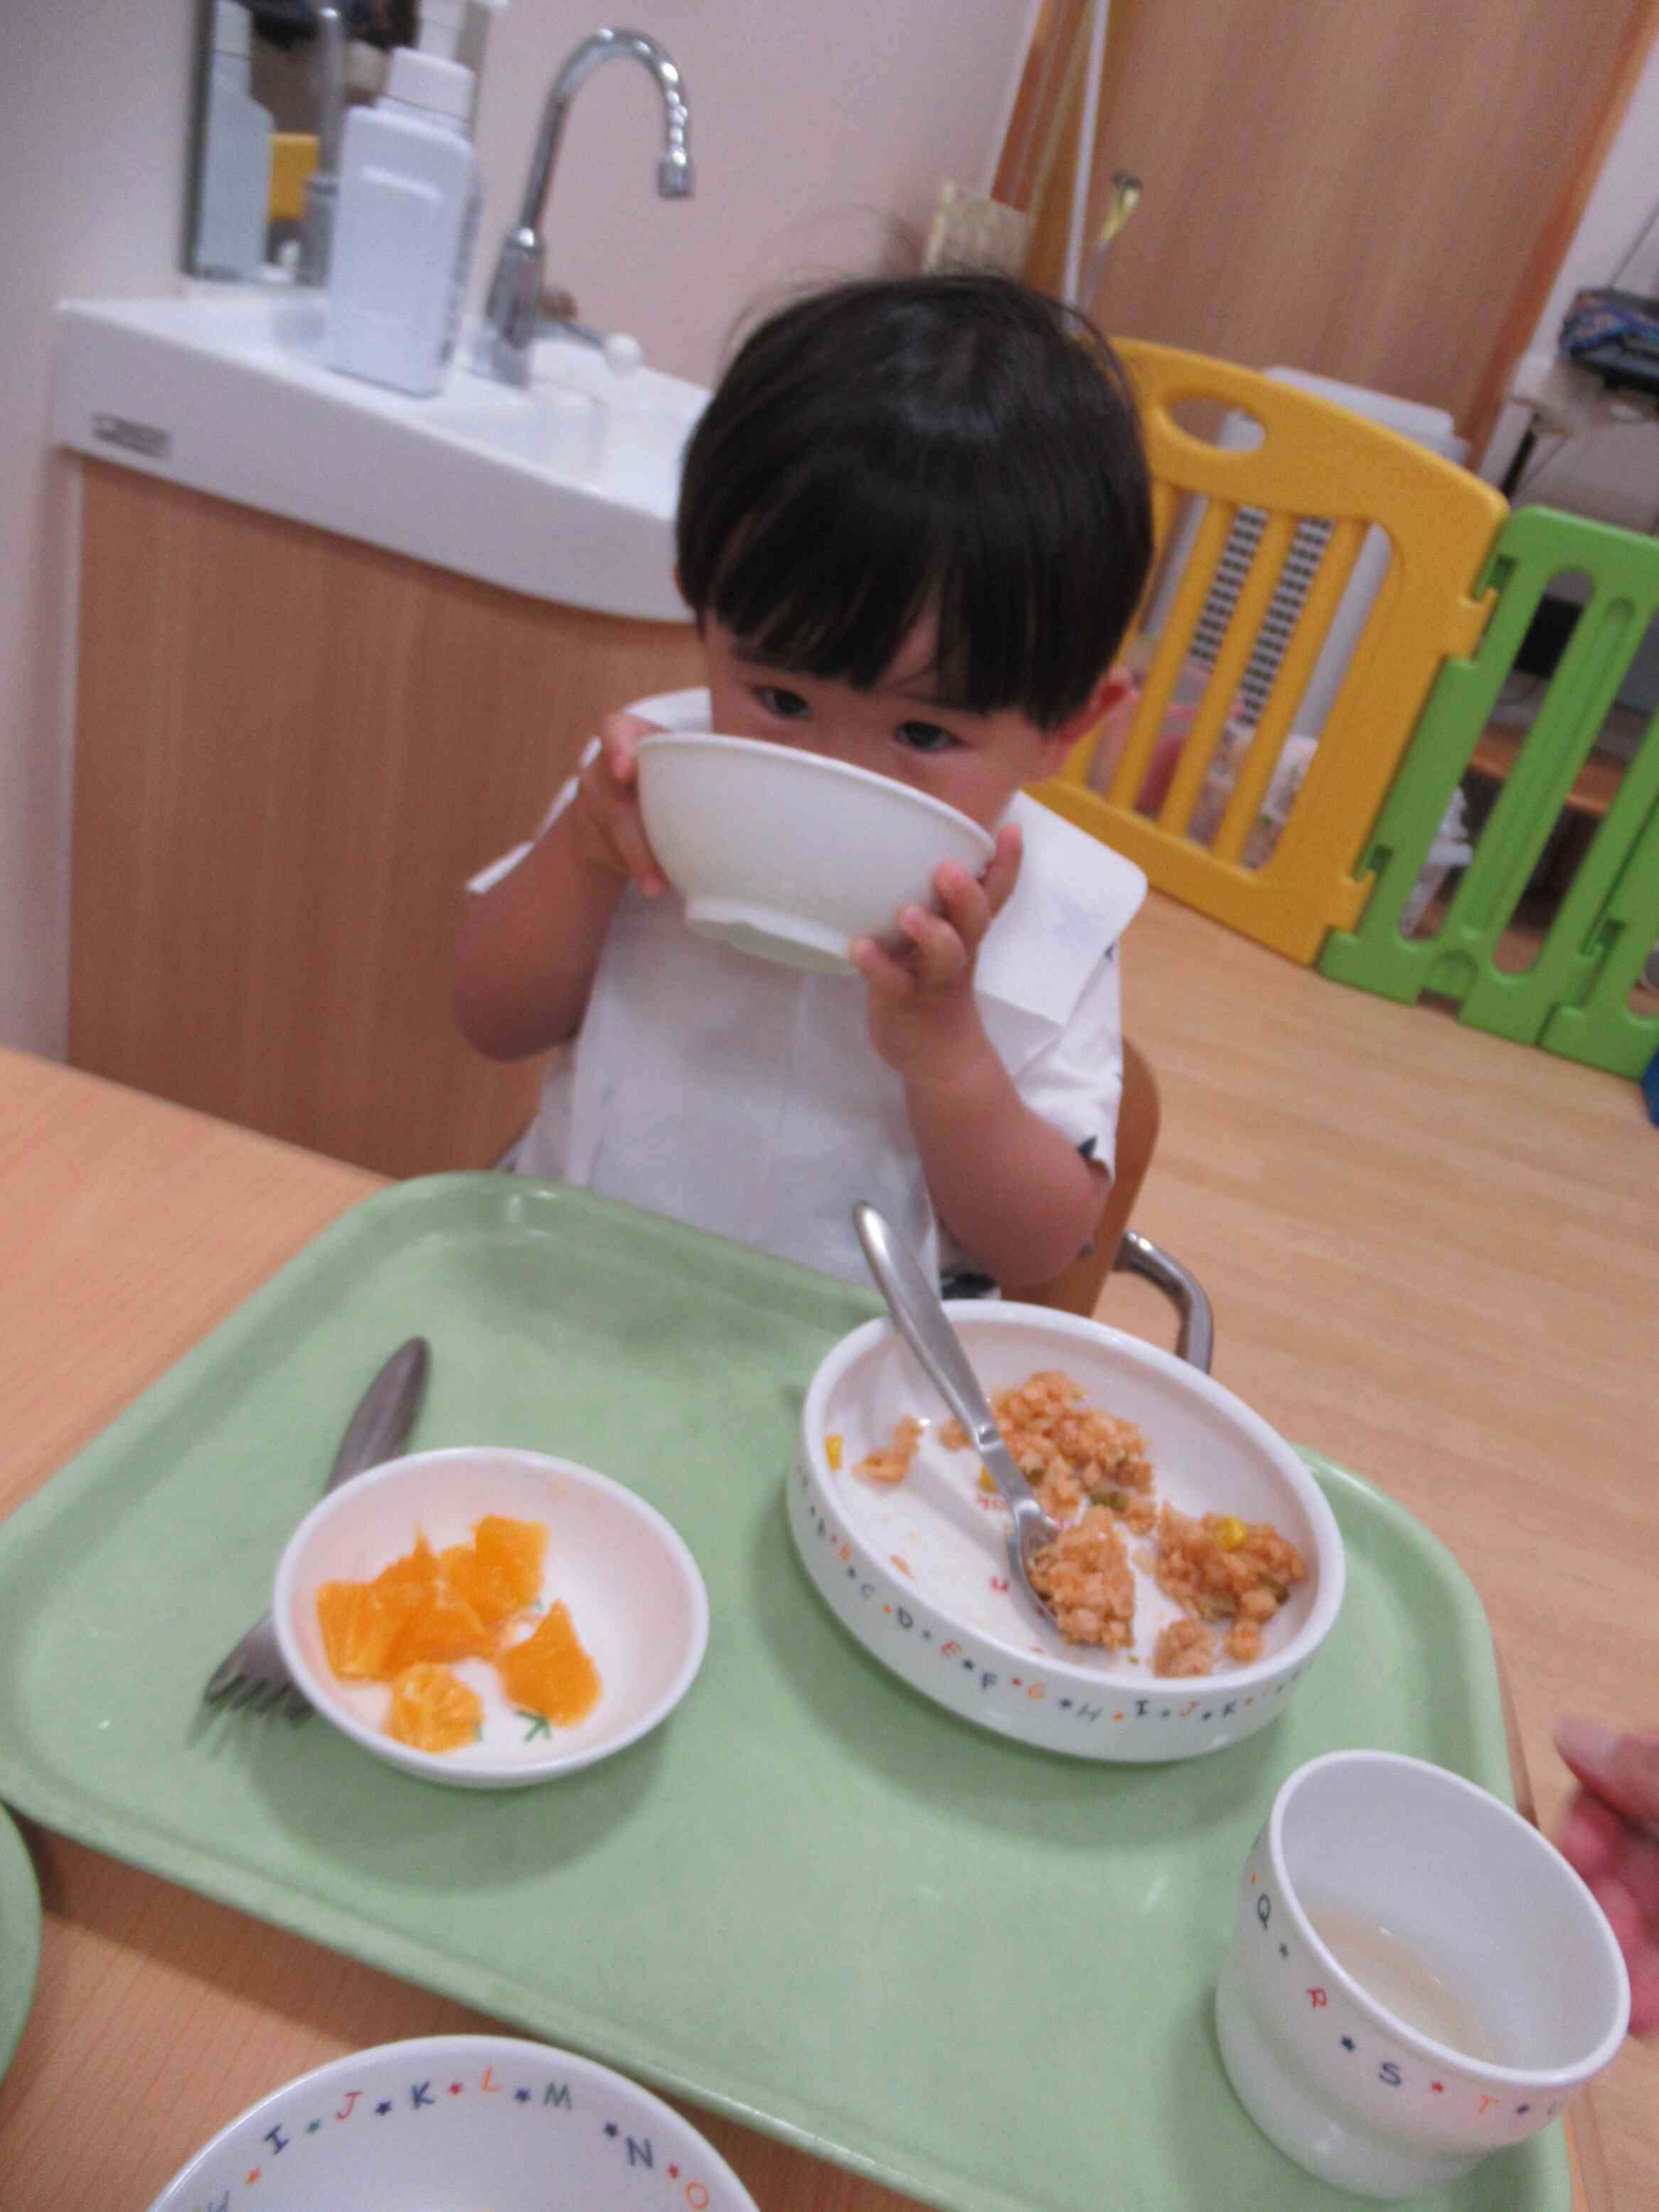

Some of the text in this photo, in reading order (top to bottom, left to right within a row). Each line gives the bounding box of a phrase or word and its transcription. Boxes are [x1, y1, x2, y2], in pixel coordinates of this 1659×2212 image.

[940, 1639, 962, 1661] E
[980, 1671, 998, 1690] F
[1026, 1683, 1047, 1702] G
[1076, 1703, 1102, 1725] H
[1136, 1698, 1149, 1717] I
[1257, 1893, 1271, 1932] Q
[1307, 1987, 1328, 2009] R
[1378, 2061, 1402, 2088] S
[263, 2122, 290, 2155] I
[335, 2090, 364, 2120] J
[410, 2080, 436, 2110] K
[481, 2064, 501, 2093] L
[543, 2081, 572, 2111] M
[626, 2134, 654, 2171] N
